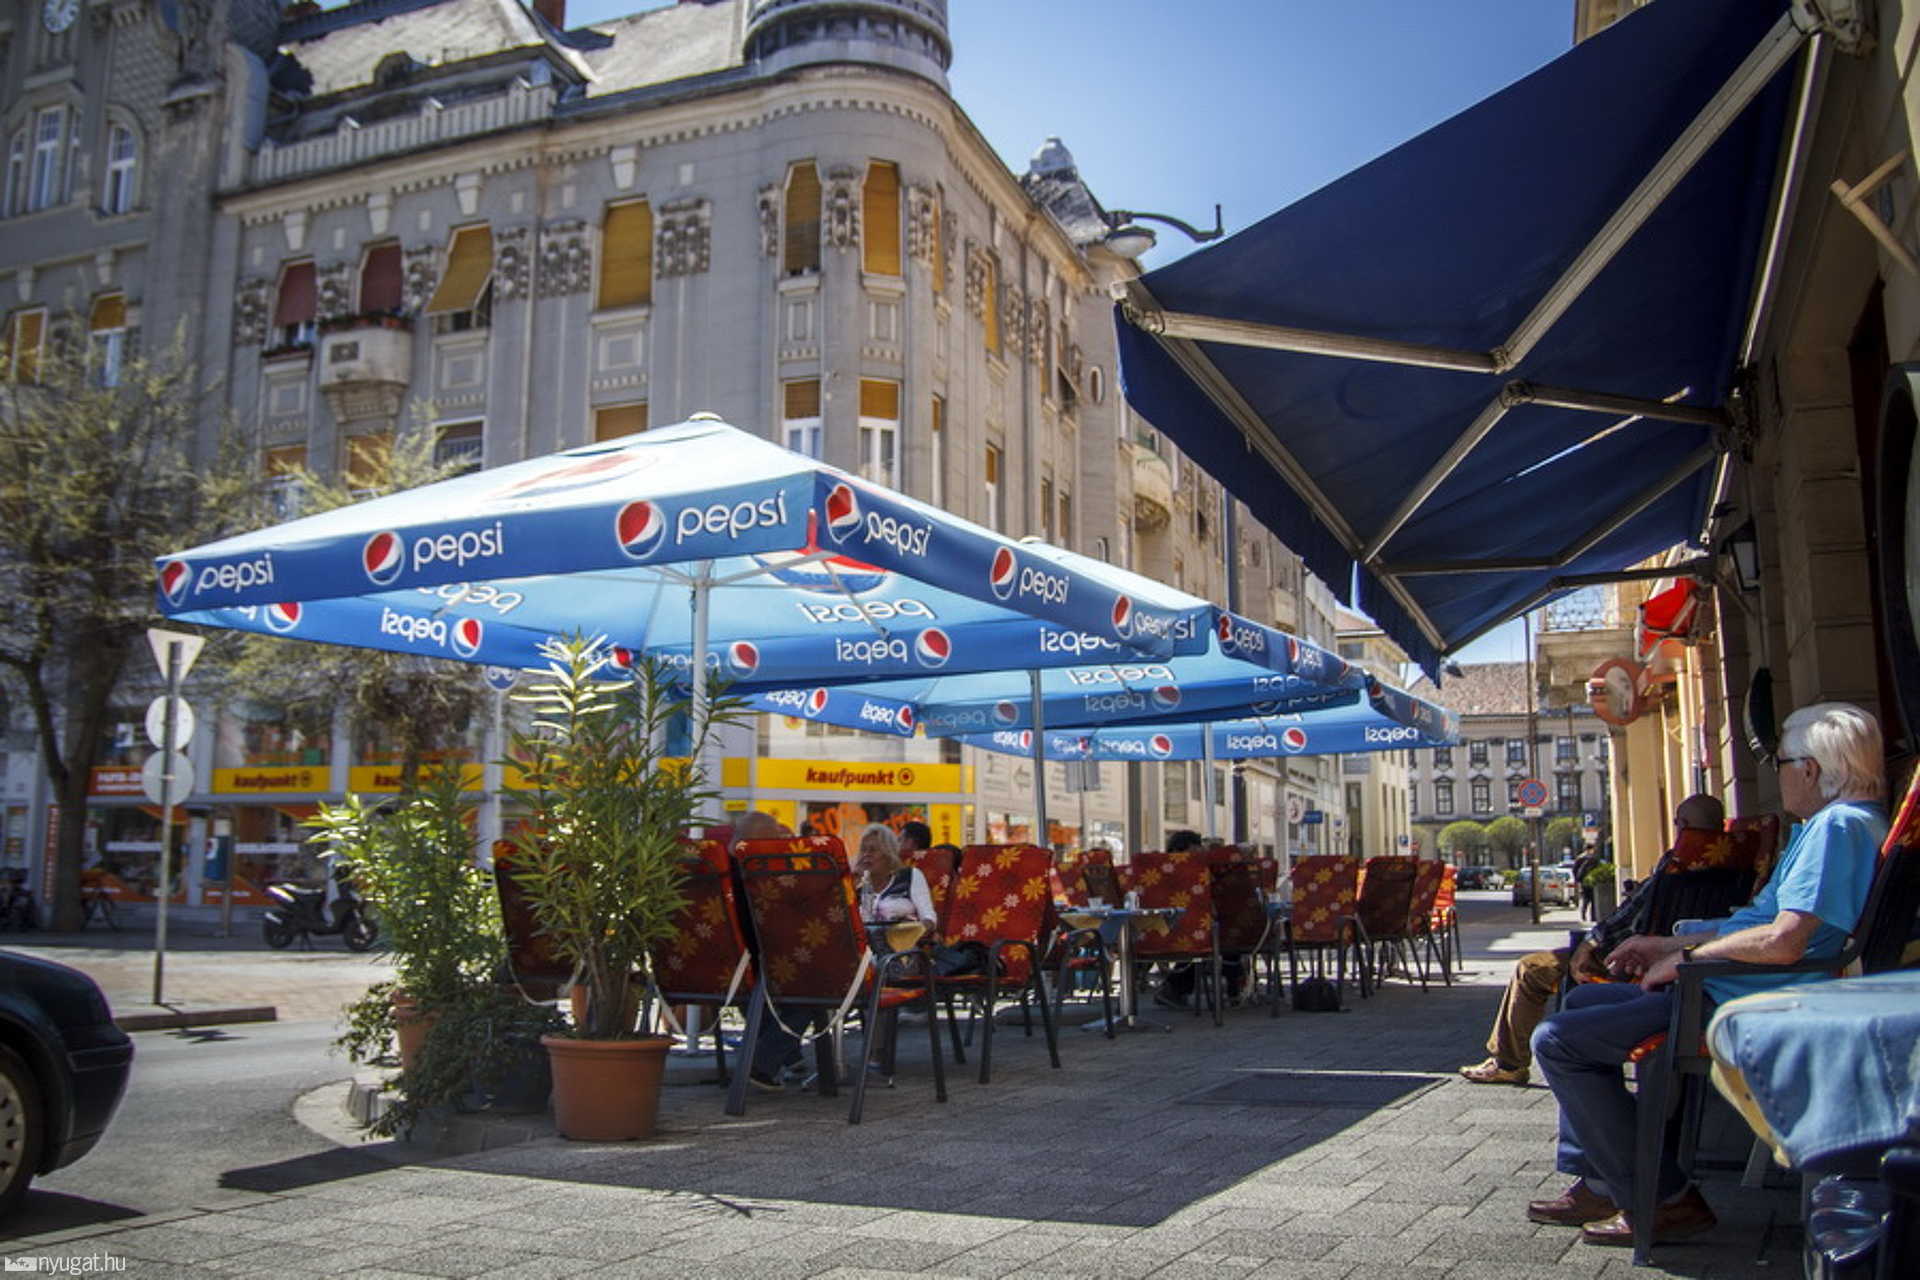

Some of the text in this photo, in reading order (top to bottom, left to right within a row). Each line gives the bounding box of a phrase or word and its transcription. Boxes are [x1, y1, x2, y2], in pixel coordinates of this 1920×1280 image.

[676, 489, 788, 545] pepsi
[864, 511, 932, 558] pepsi
[413, 521, 504, 572] pepsi
[195, 553, 275, 596] pepsi
[1019, 566, 1070, 605] pepsi
[805, 767, 895, 788] kaufpunkt
